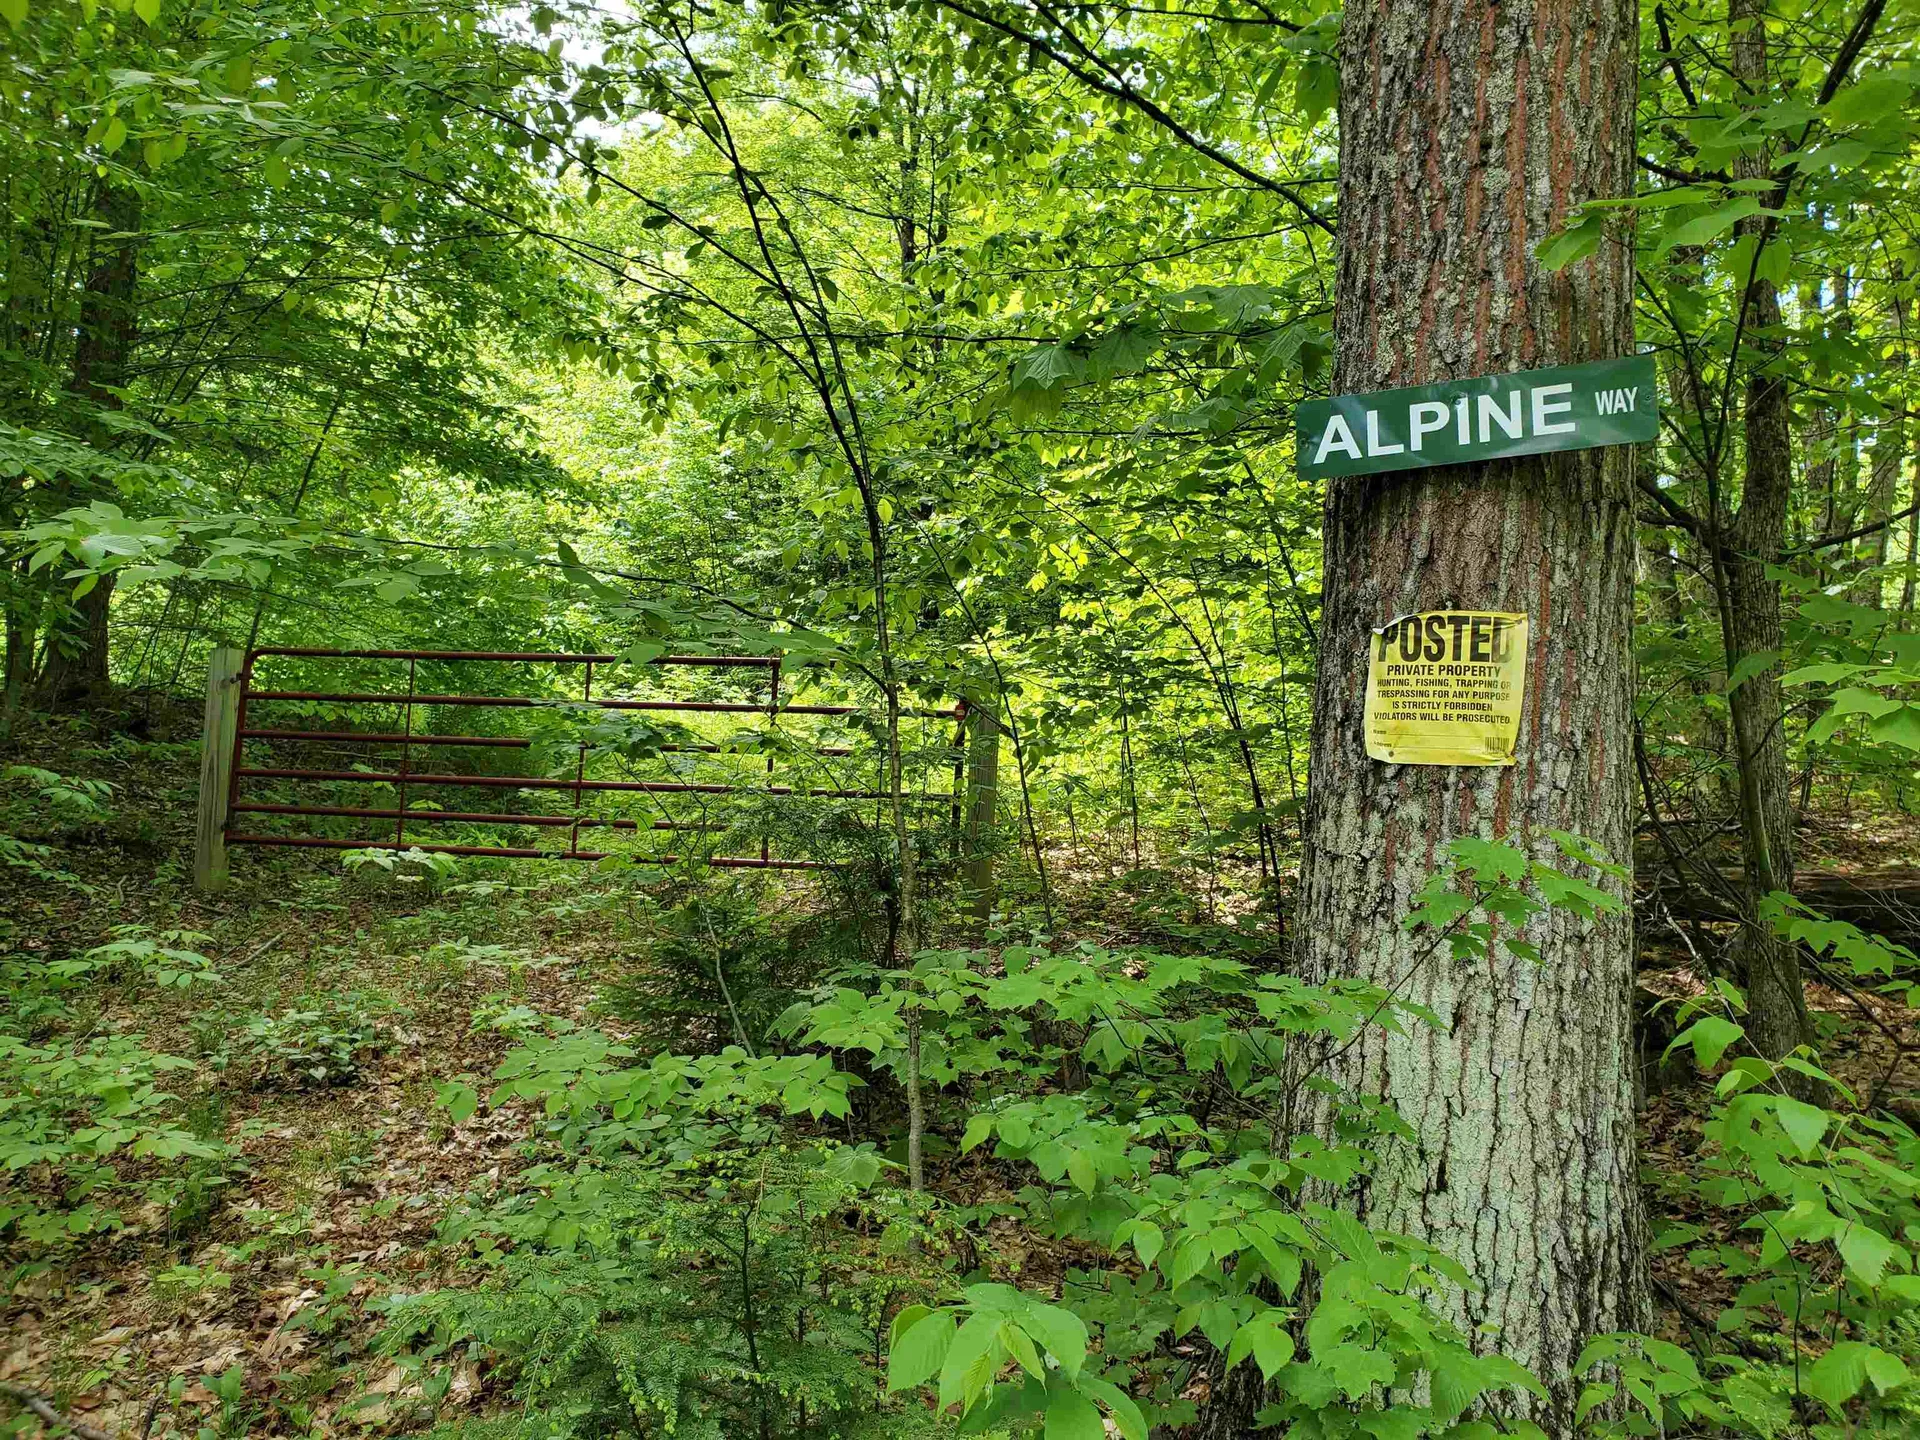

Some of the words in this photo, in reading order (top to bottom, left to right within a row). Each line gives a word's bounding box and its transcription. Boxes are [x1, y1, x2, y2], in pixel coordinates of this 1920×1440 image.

[1313, 383, 1576, 464] ALPINE
[1595, 387, 1638, 416] WAY
[1377, 615, 1516, 663] POSTED
[1387, 664, 1434, 676] PRIVATE
[1438, 664, 1501, 678] PROPERTY
[1377, 678, 1413, 688] HUNTING,
[1415, 678, 1453, 689] FISHING,
[1456, 679, 1499, 689] TRAPPING
[1500, 680, 1512, 690] OR
[1377, 689, 1430, 699] TRESPASSING
[1432, 690, 1450, 699] FOR
[1452, 690, 1470, 699] ANY
[1472, 691, 1510, 701] PURPOSE
[1392, 701, 1400, 709] IS
[1401, 701, 1441, 710] STRICTLY
[1444, 701, 1493, 712] FORBIDDEN
[1374, 712, 1417, 721] VIOLATORS
[1419, 713, 1440, 722] WILL
[1442, 713, 1454, 722] BE
[1456, 714, 1511, 725] PROSECUTED
